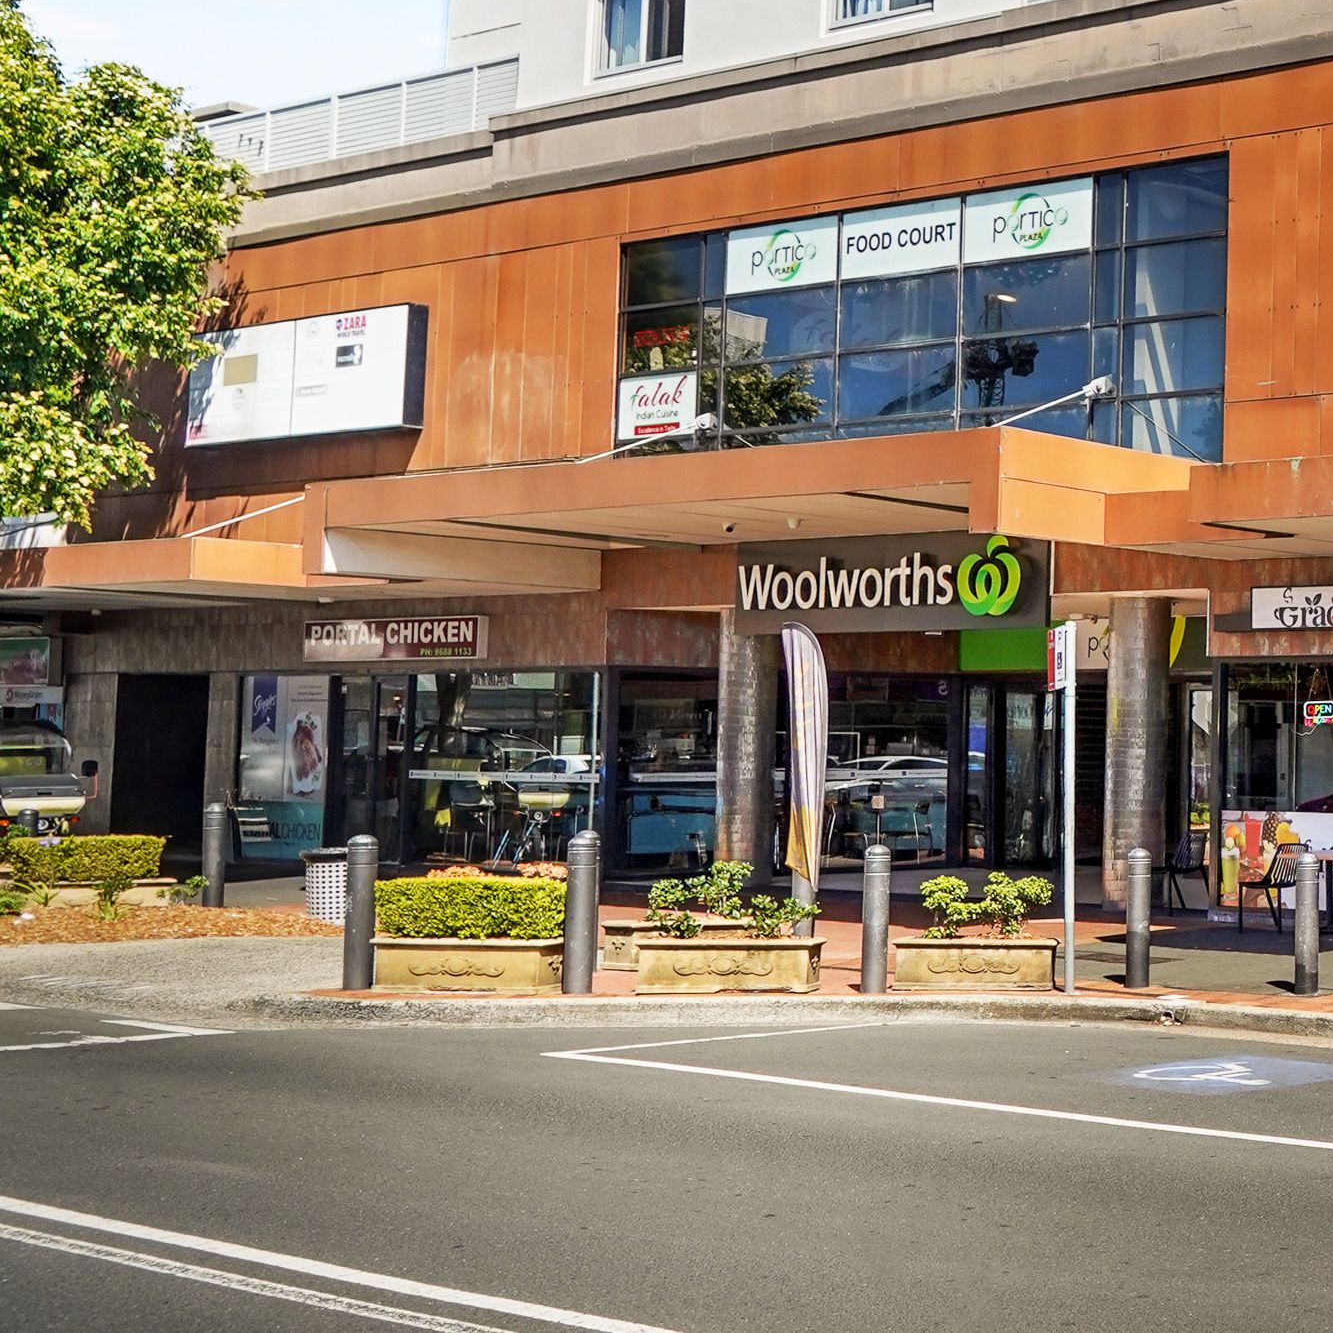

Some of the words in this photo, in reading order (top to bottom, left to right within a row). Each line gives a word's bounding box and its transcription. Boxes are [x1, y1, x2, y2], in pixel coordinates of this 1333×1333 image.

[846, 232, 892, 255] FOOD
[897, 222, 957, 248] COURT
[1020, 232, 1043, 243] PLAZA
[774, 265, 796, 275] PLAZA
[343, 315, 367, 331] ZARA
[630, 375, 688, 410] falak
[636, 412, 655, 420] Indian
[657, 409, 679, 419] Cuisine
[738, 551, 954, 611] Woolworths
[310, 622, 381, 647] PORTAL
[386, 620, 474, 645] CHICKEN
[454, 647, 472, 656] 1133
[1307, 704, 1333, 715] OPEN
